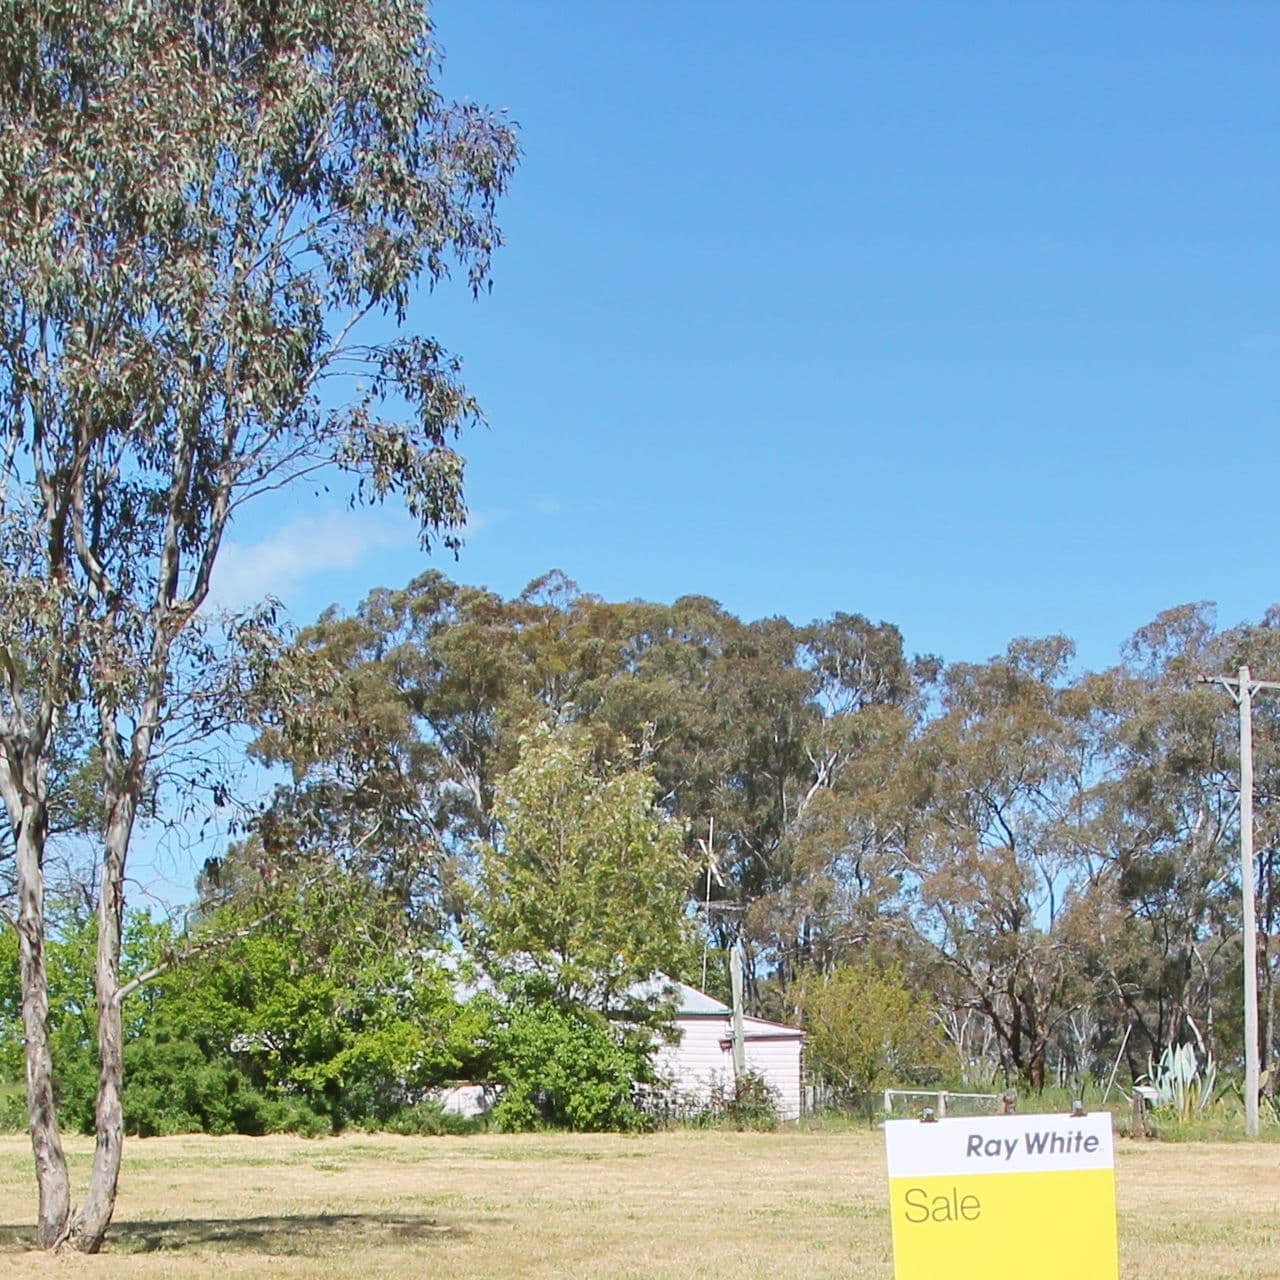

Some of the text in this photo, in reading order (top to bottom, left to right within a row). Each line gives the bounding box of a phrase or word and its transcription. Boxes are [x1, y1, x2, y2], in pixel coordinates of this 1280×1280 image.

[966, 1131, 1100, 1160] Ray White
[904, 1187, 981, 1223] Sale
